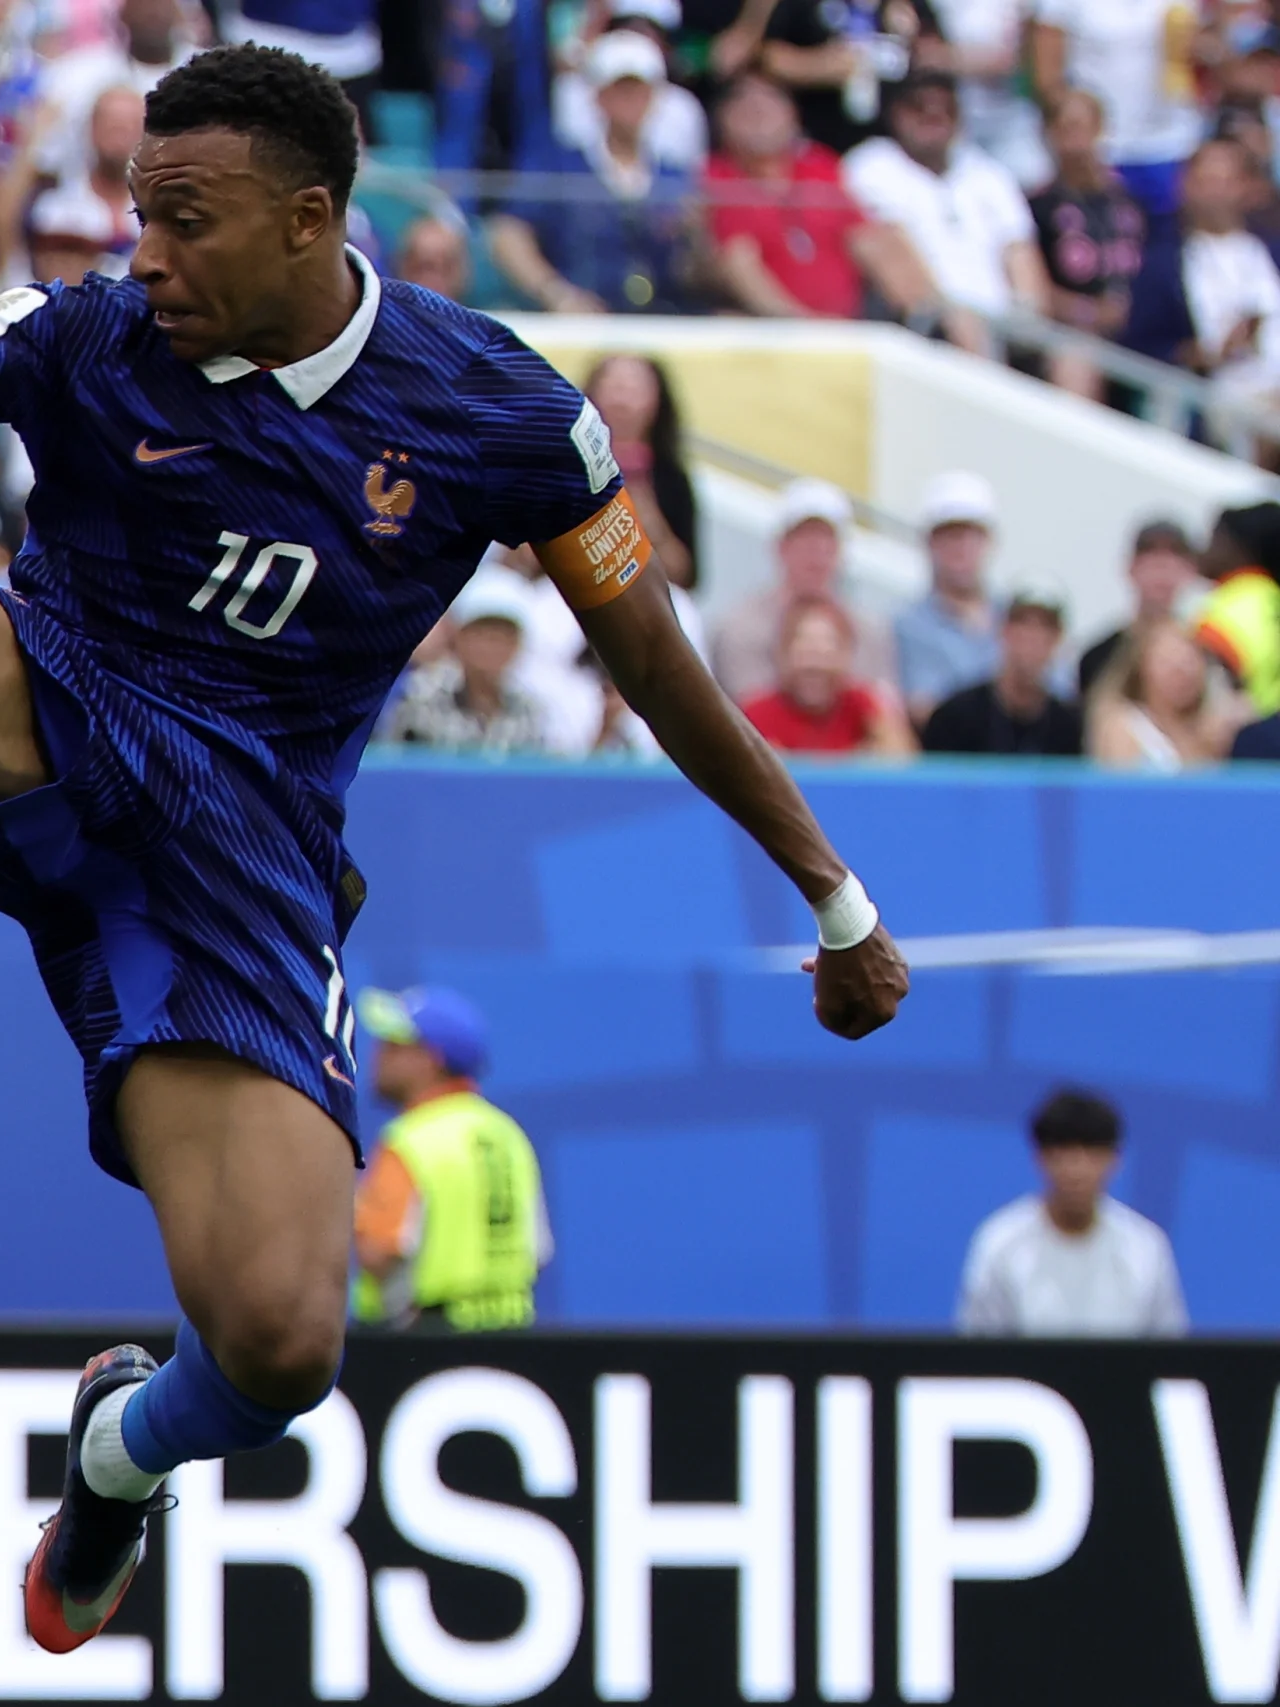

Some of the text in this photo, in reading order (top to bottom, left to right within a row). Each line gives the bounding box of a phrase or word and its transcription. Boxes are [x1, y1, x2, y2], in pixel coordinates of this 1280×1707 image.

[579, 498, 623, 548] FOOTBALL
[585, 508, 634, 565] UNITES
[593, 523, 641, 585] the World
[619, 561, 637, 583] FIFA
[187, 530, 318, 640] 10
